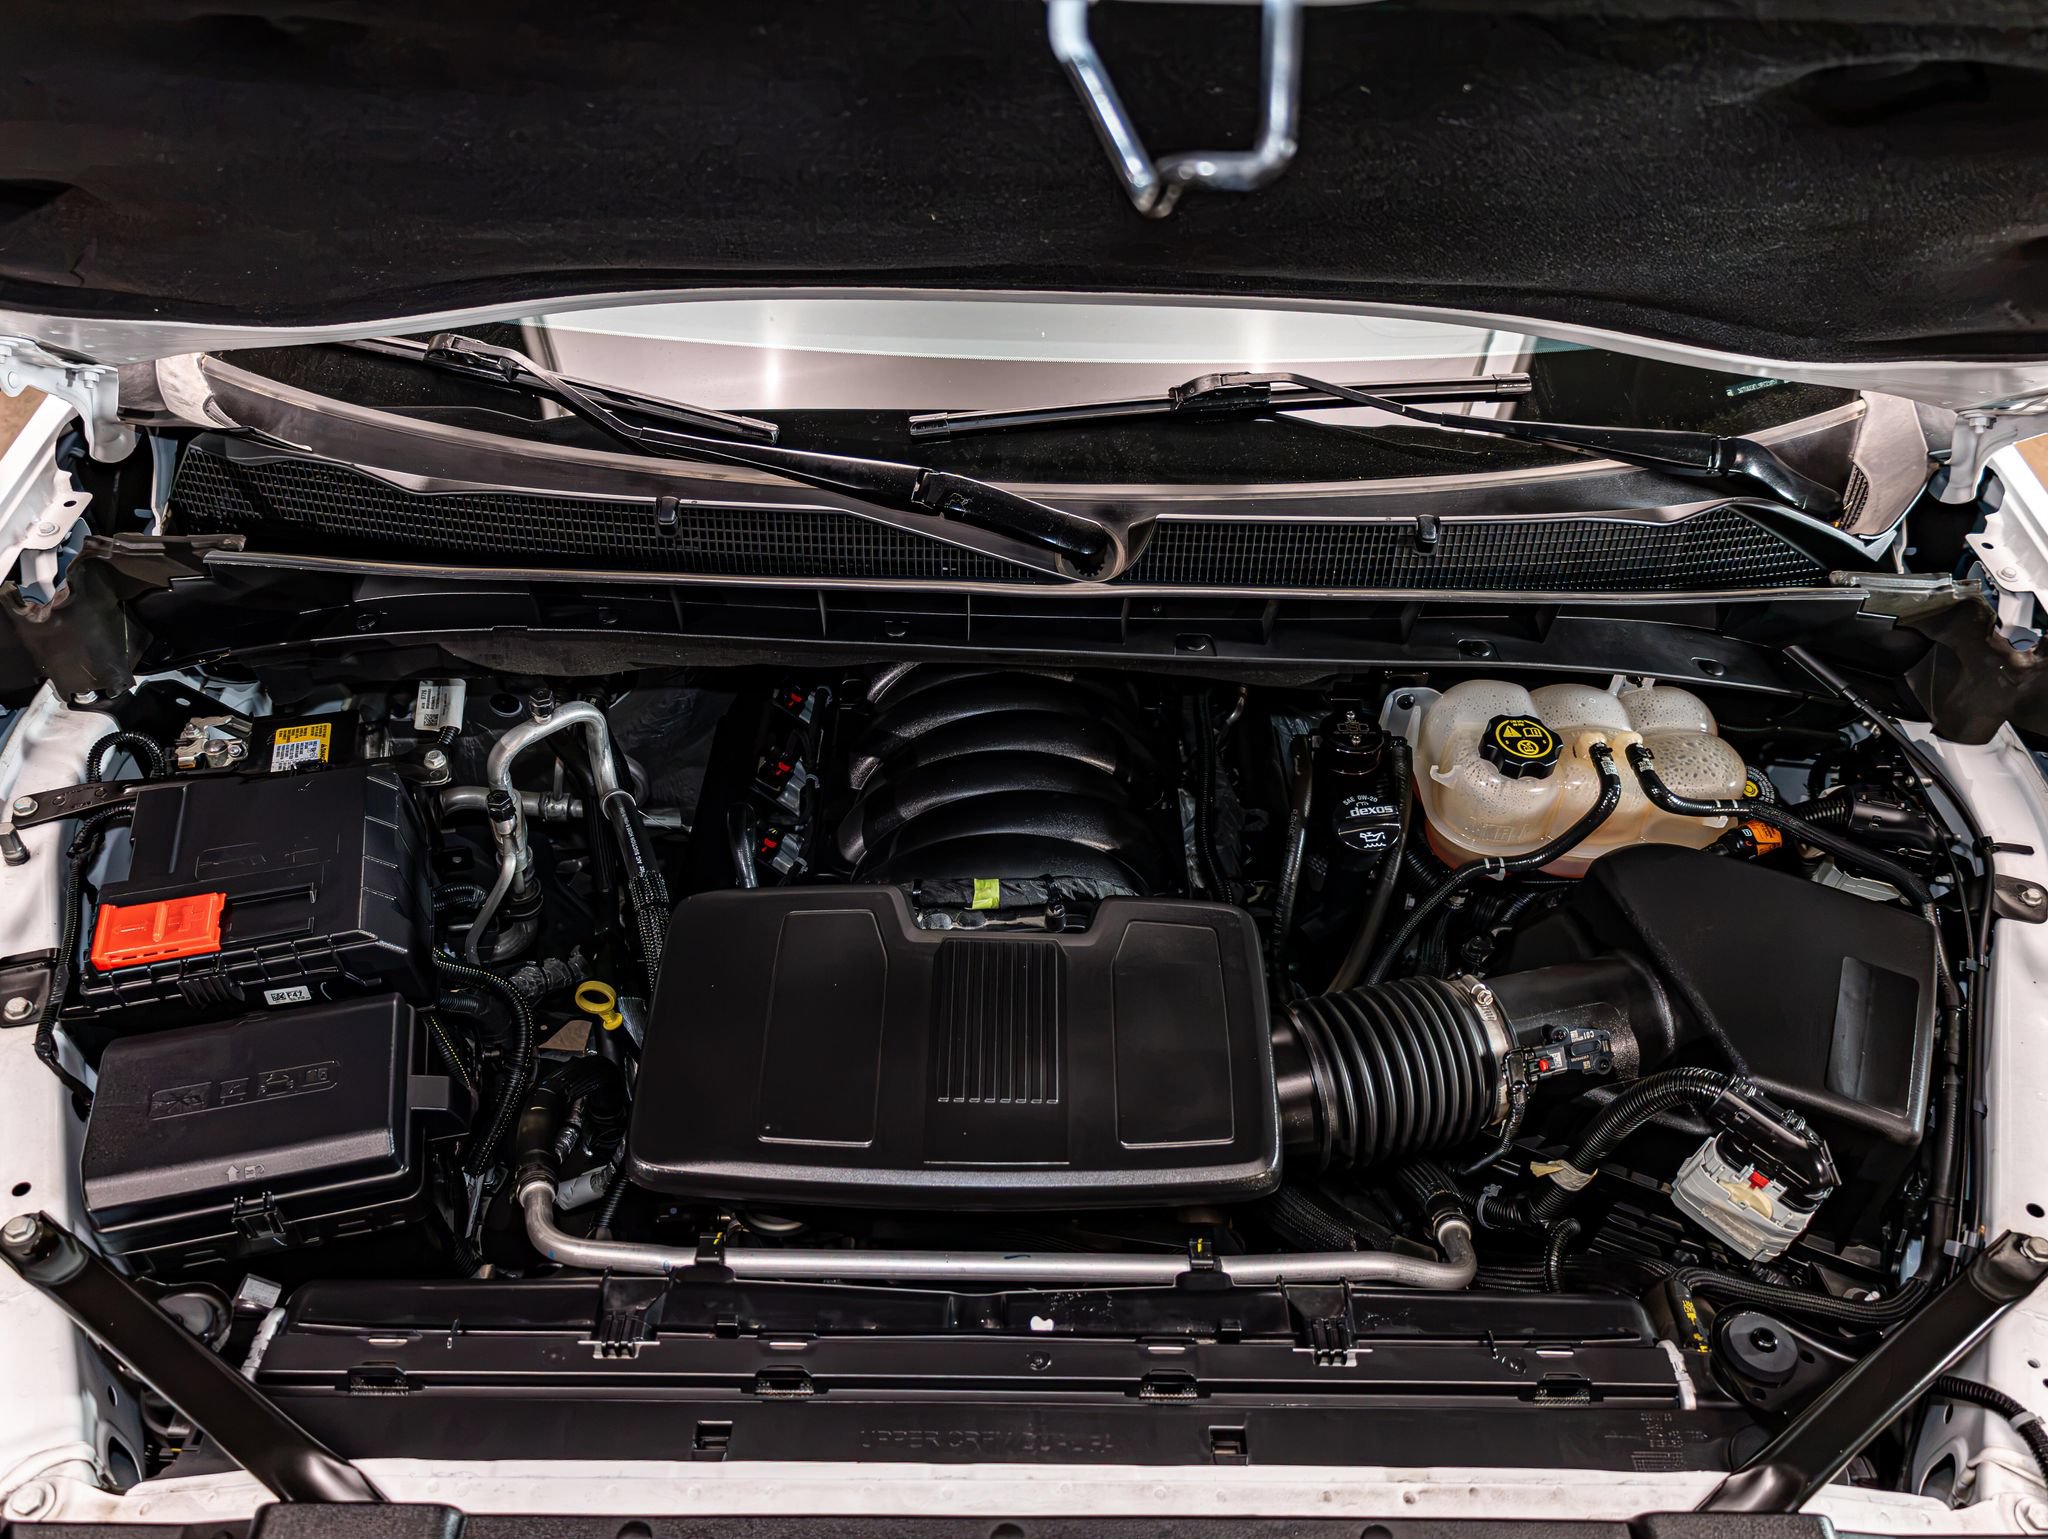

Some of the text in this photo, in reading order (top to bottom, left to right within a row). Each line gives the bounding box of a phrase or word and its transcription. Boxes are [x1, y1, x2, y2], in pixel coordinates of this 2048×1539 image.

[1342, 794, 1378, 806] SAE 0W-20
[1350, 805, 1393, 817] dexos
